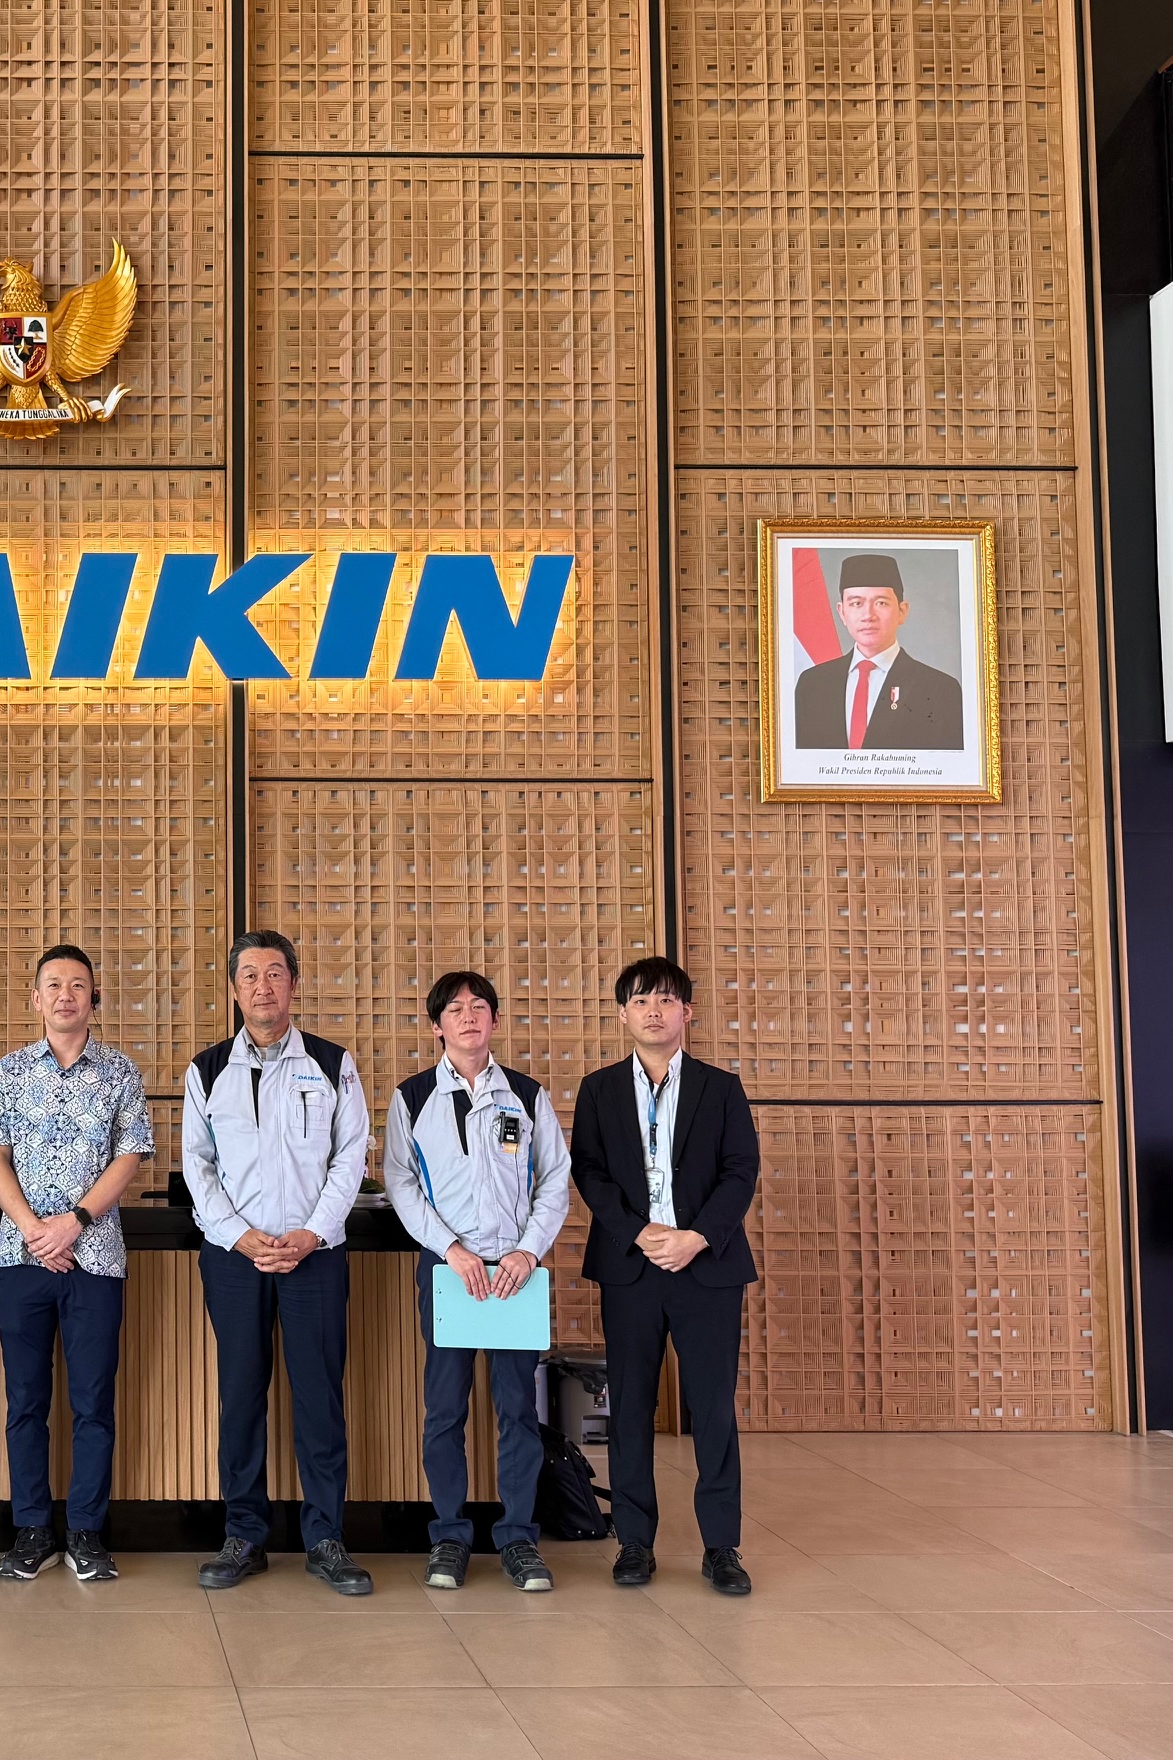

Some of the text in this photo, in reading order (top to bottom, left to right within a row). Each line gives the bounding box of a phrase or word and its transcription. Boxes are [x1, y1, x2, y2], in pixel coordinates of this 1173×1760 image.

[23, 410, 57, 419] TUNGGAL
[844, 753, 916, 763] Gibran Rakabuming
[818, 766, 942, 776] Wakil Presiden Republik Indonesia
[499, 1106, 522, 1114] DAIKIN
